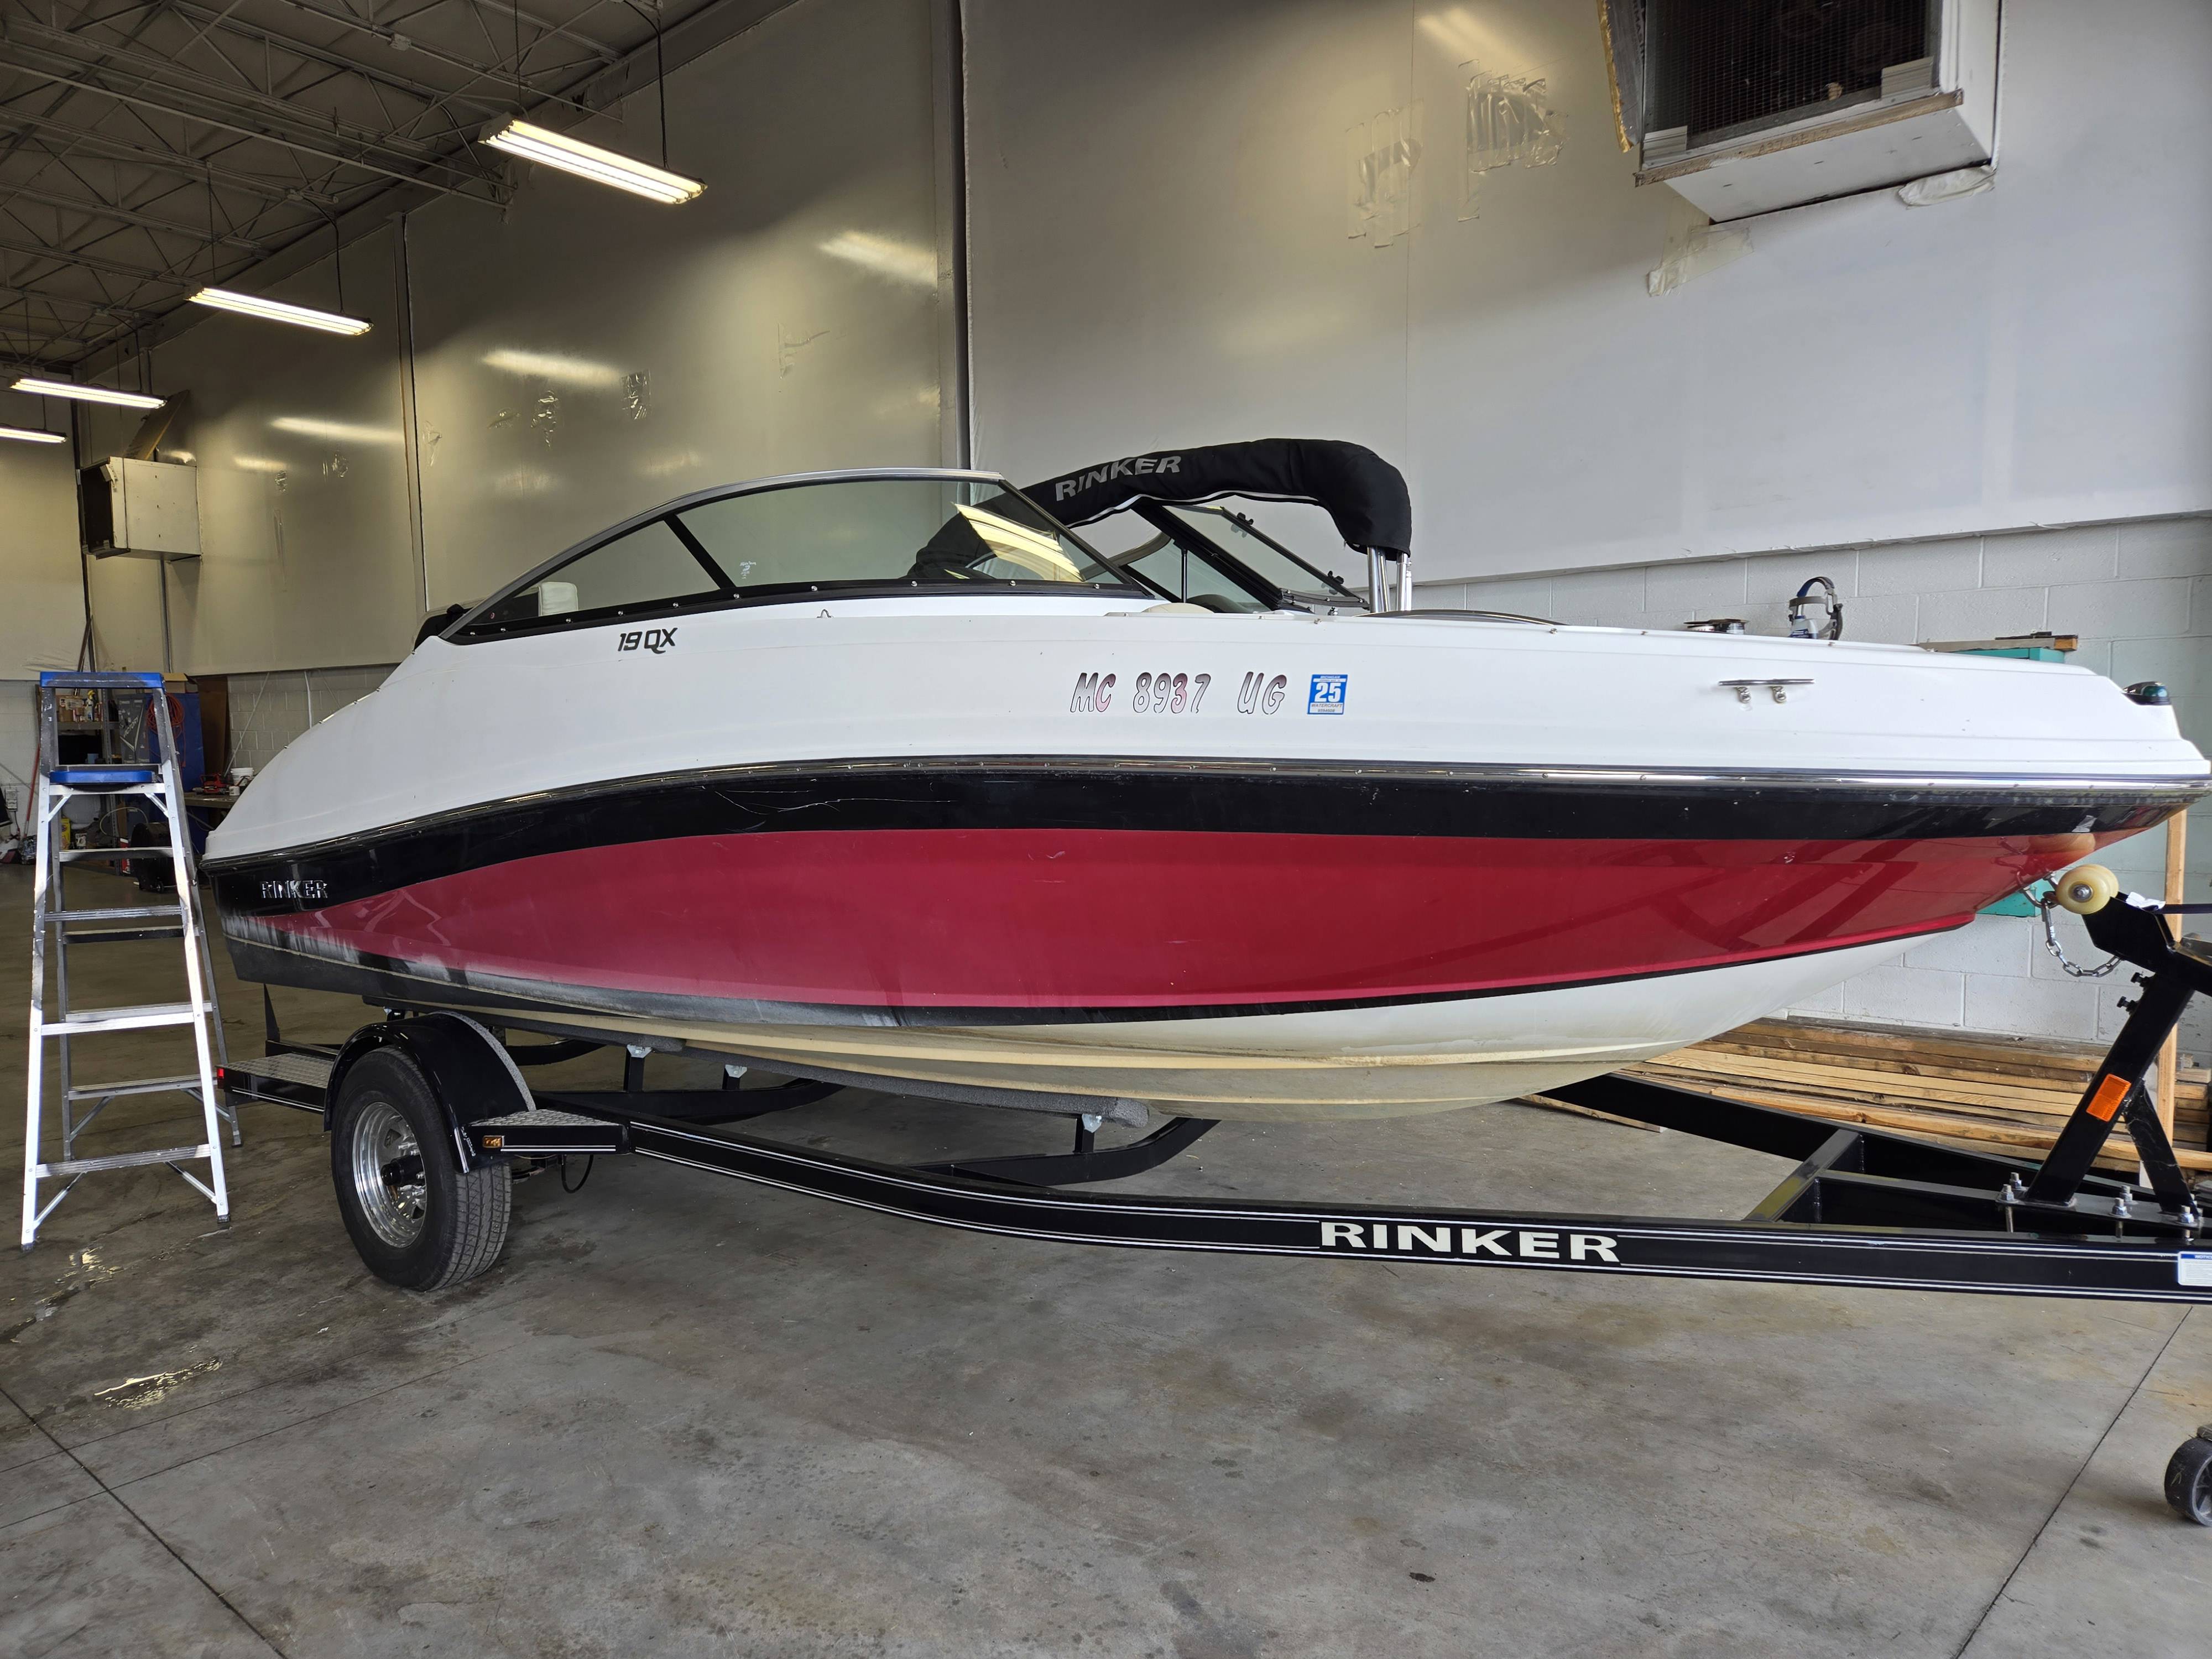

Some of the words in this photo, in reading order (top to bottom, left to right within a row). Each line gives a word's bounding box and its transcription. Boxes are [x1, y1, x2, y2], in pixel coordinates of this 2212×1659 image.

[1056, 456, 1181, 502] RINKER
[618, 632, 643, 651] 19
[644, 628, 678, 654] QX
[1070, 672, 1116, 712] MC
[1133, 672, 1211, 713] 8937
[1237, 671, 1287, 714] UG
[1314, 682, 1341, 702] 25
[259, 880, 327, 898] RINKER
[1322, 1222, 1620, 1262] RINKER
